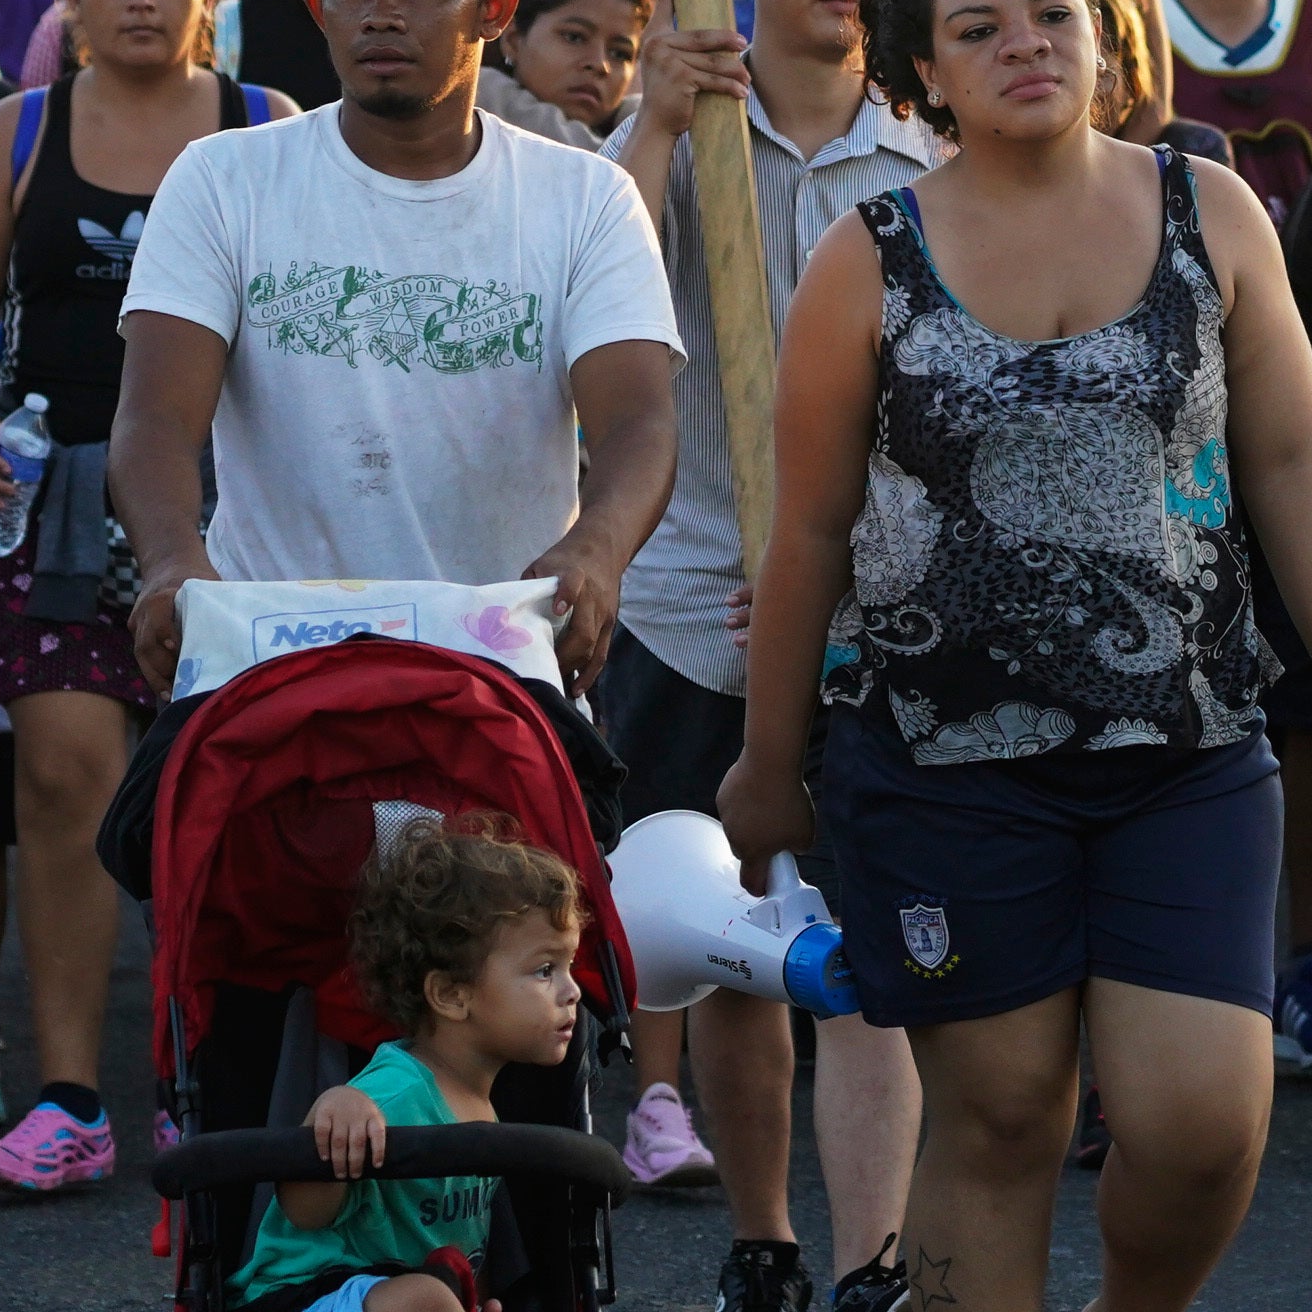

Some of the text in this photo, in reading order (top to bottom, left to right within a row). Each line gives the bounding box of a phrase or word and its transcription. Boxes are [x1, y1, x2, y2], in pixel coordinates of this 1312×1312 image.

[260, 280, 338, 319] COURAGE
[369, 279, 444, 306] WISDOM
[459, 306, 520, 337] POWER
[269, 619, 372, 647] Neto
[907, 916, 939, 925] PACHUCA
[707, 953, 739, 973] Steren
